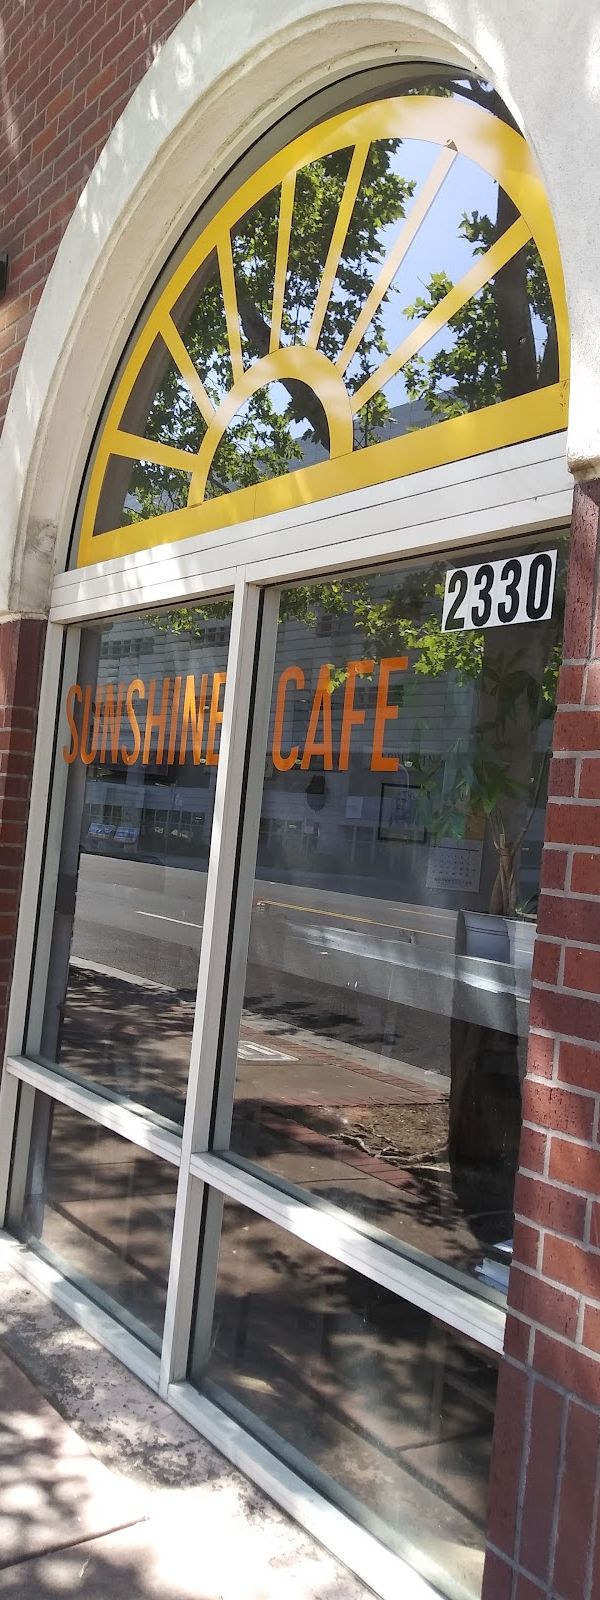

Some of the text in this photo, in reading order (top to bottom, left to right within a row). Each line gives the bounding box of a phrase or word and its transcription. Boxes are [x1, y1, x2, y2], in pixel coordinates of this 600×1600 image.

[444, 553, 553, 631] 2330
[62, 656, 409, 772] SUNSHINE CAFE
